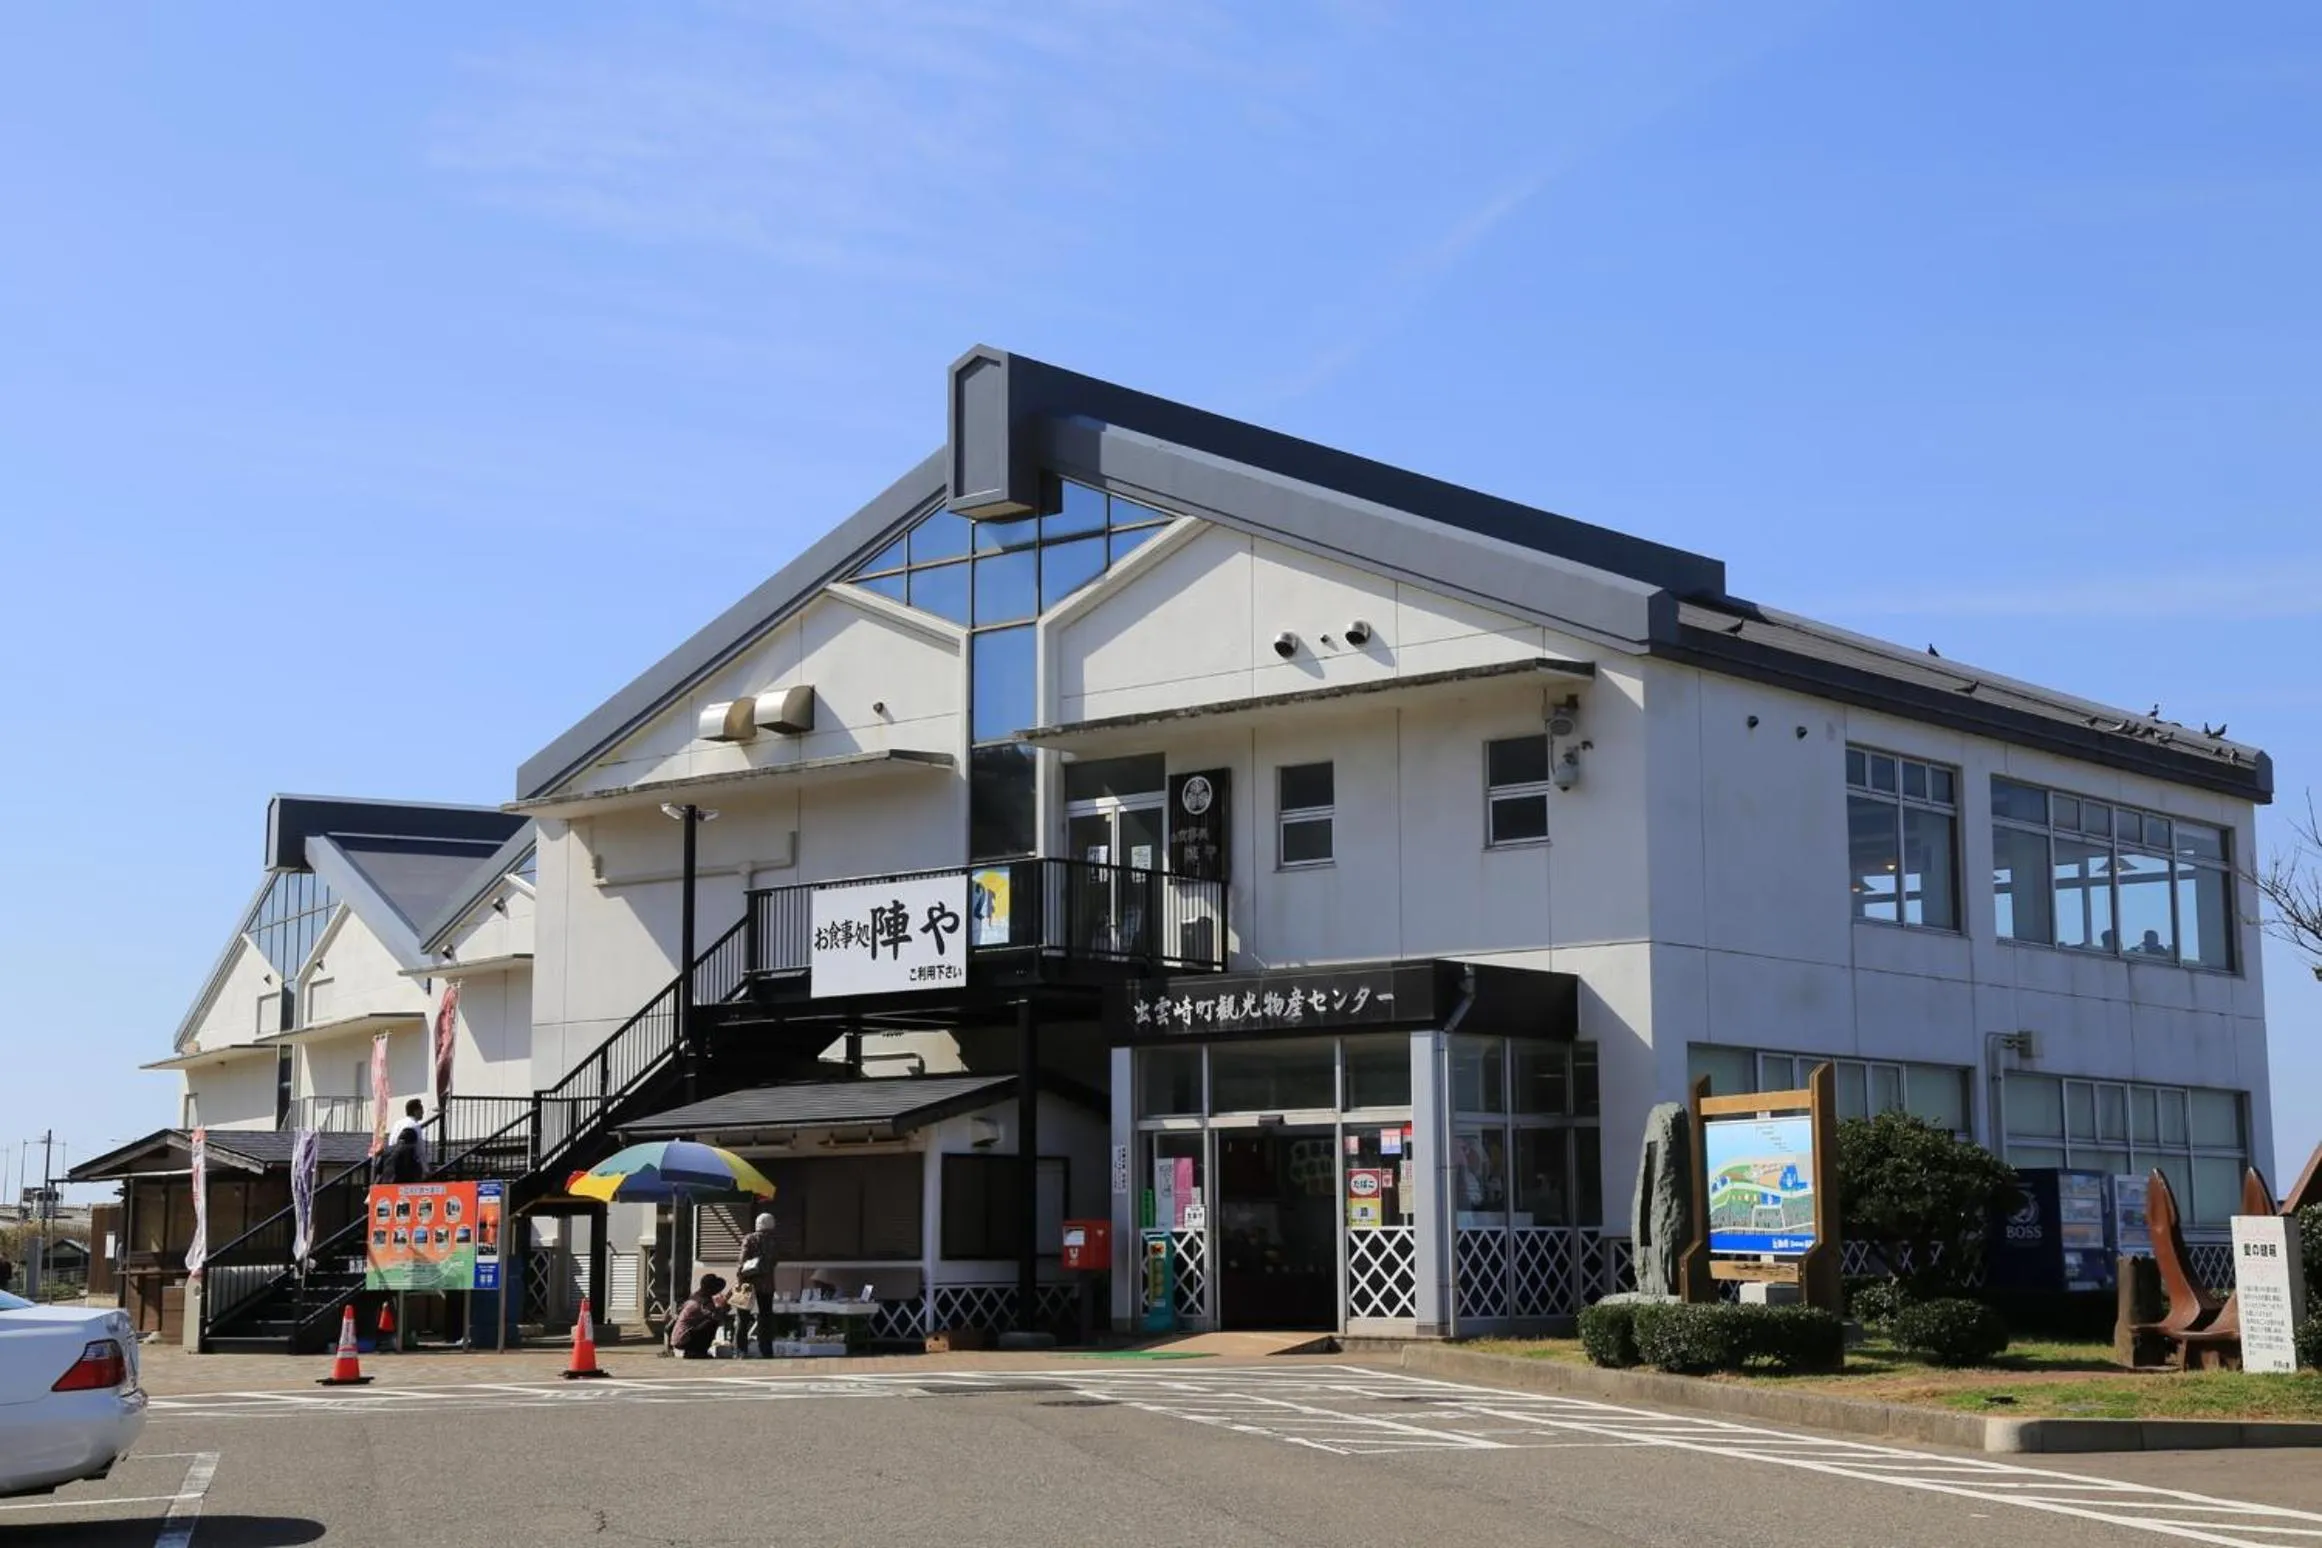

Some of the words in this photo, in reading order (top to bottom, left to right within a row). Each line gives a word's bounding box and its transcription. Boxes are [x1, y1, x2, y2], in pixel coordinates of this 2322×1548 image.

[814, 919, 871, 951] お食事処
[869, 899, 961, 961] 陣や
[909, 964, 962, 982] ご利用下さい
[1133, 985, 1394, 1026] 出雲崎町観光物産センター
[1353, 1179, 1375, 1189] たばこ
[2006, 1225, 2042, 1239] BOSS
